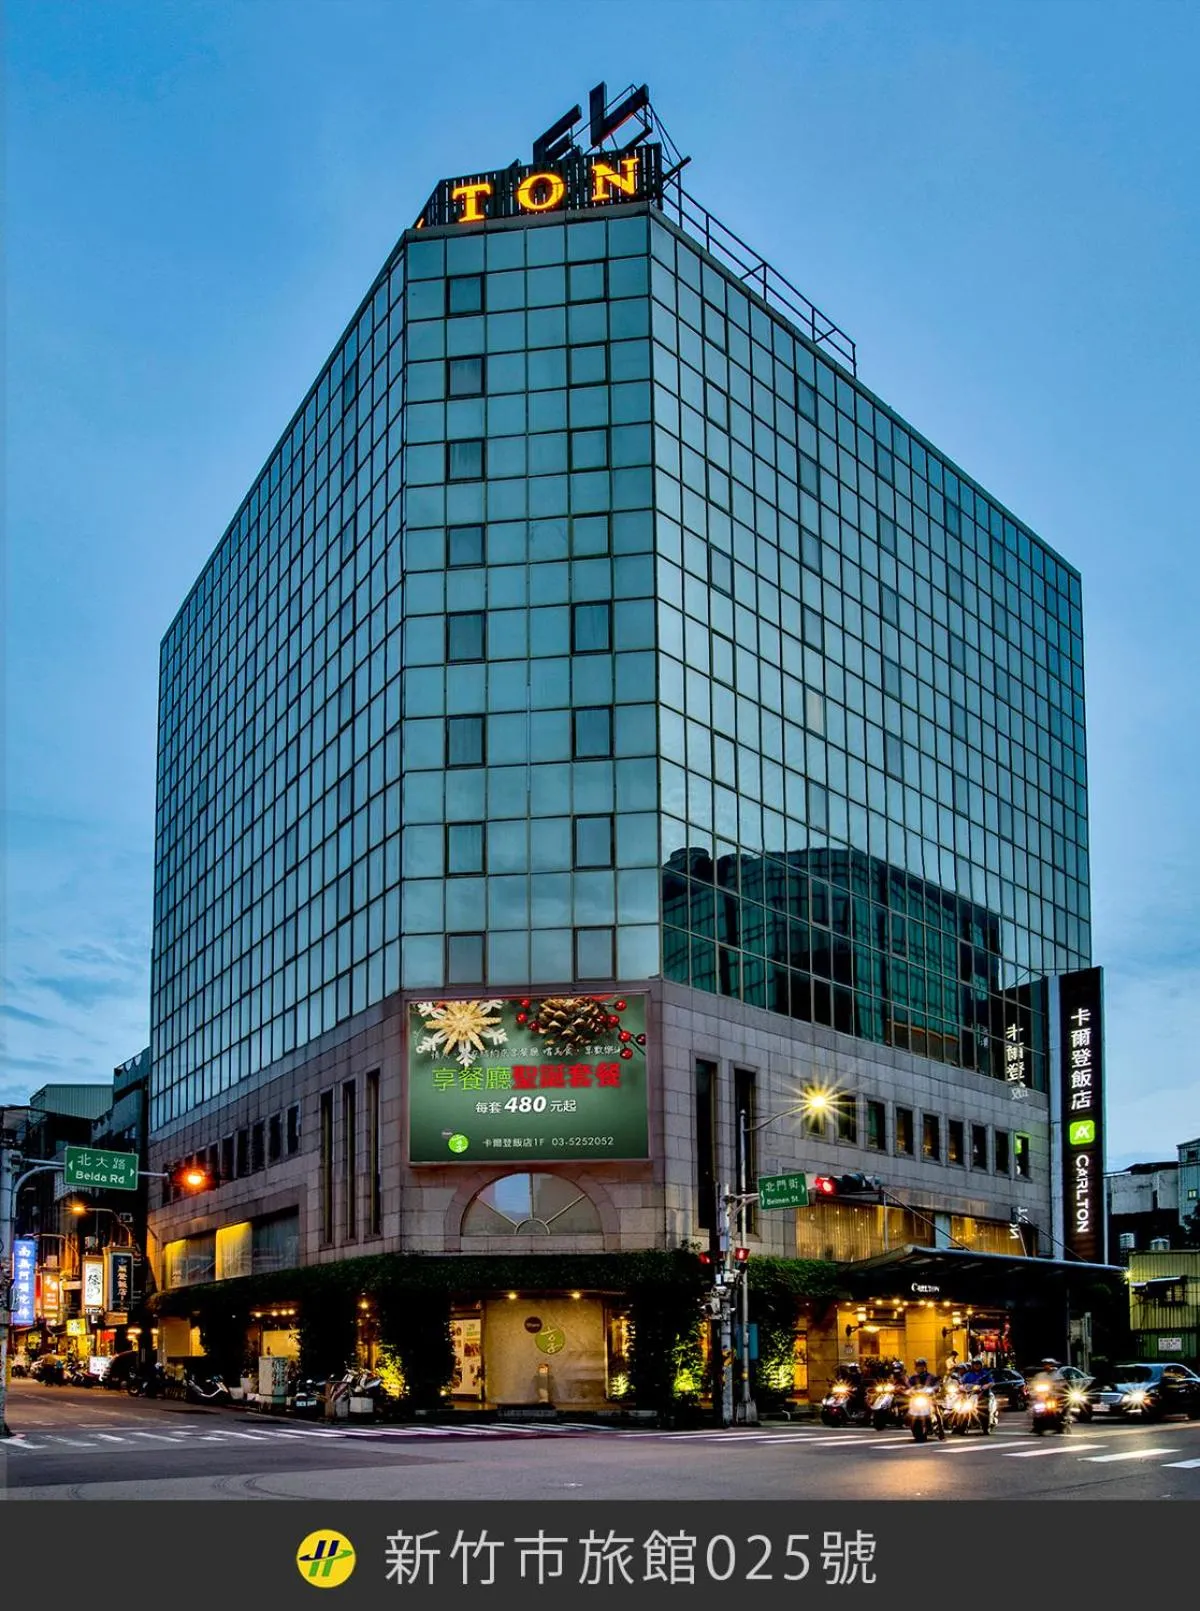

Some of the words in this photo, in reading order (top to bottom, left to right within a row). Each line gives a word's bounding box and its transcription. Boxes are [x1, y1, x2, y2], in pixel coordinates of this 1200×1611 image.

[1070, 1007, 1092, 1111] 卡爾登飯店
[475, 1102, 501, 1114] 每套
[504, 1096, 546, 1113] 480
[550, 1100, 577, 1113] 元起
[77, 1152, 126, 1170] 北大路
[75, 1170, 107, 1182] Beida
[765, 1177, 799, 1192] 北門街
[1075, 1154, 1090, 1233] CARLTON
